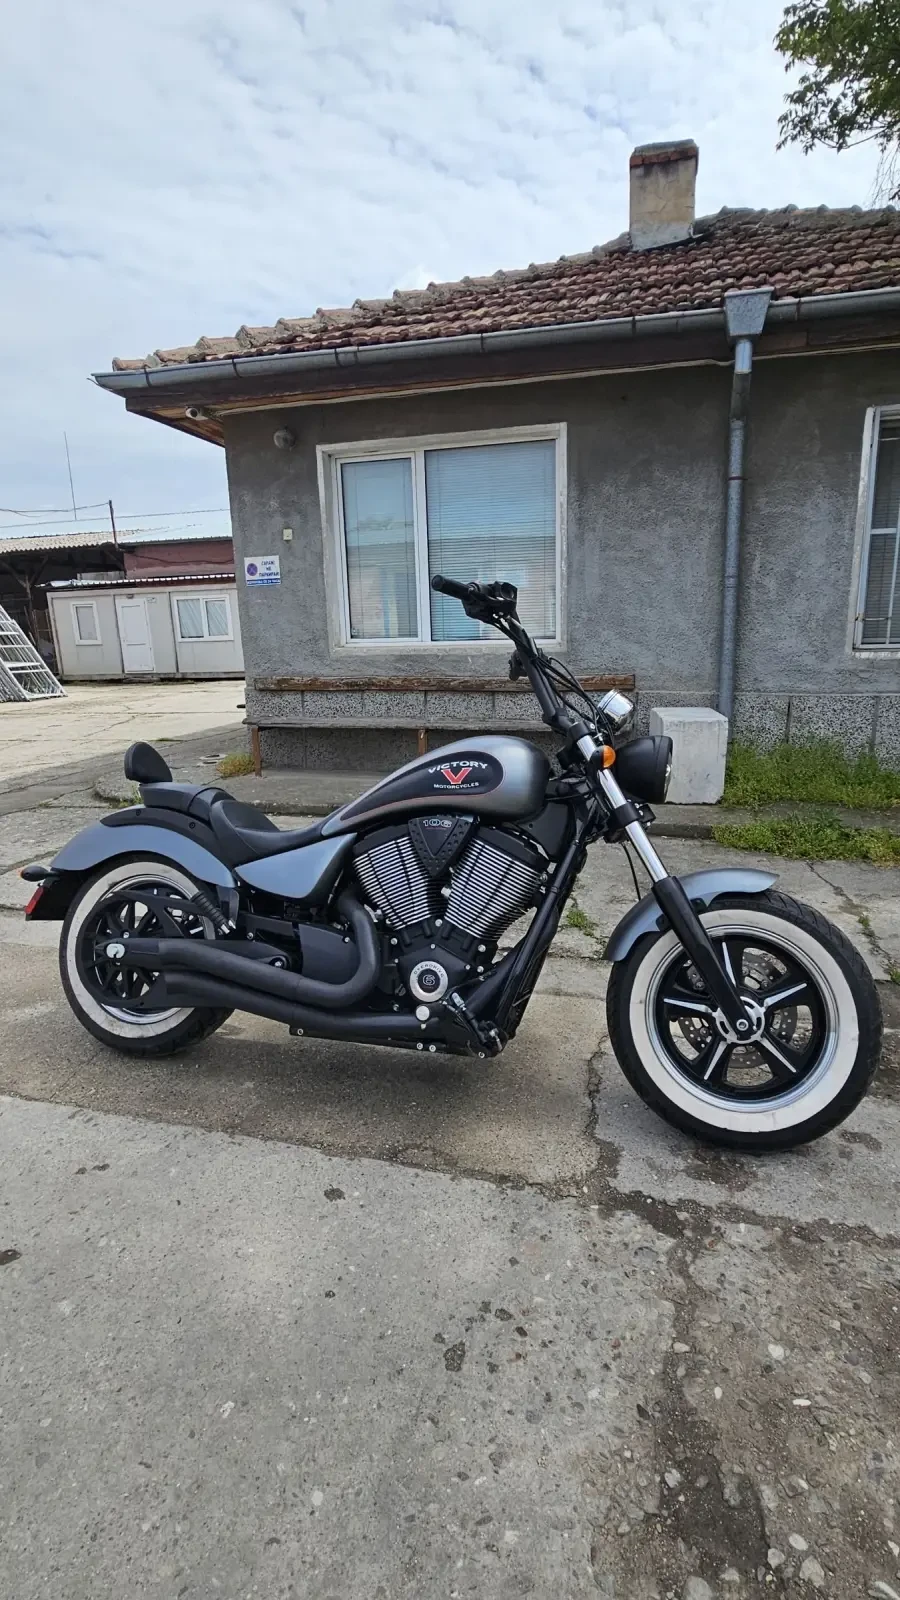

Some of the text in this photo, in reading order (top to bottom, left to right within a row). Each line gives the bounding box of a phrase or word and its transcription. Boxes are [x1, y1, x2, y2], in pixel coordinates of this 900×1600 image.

[428, 761, 488, 774] VICTORY
[423, 819, 452, 828] 106
[413, 963, 445, 978] OVERDRIVE
